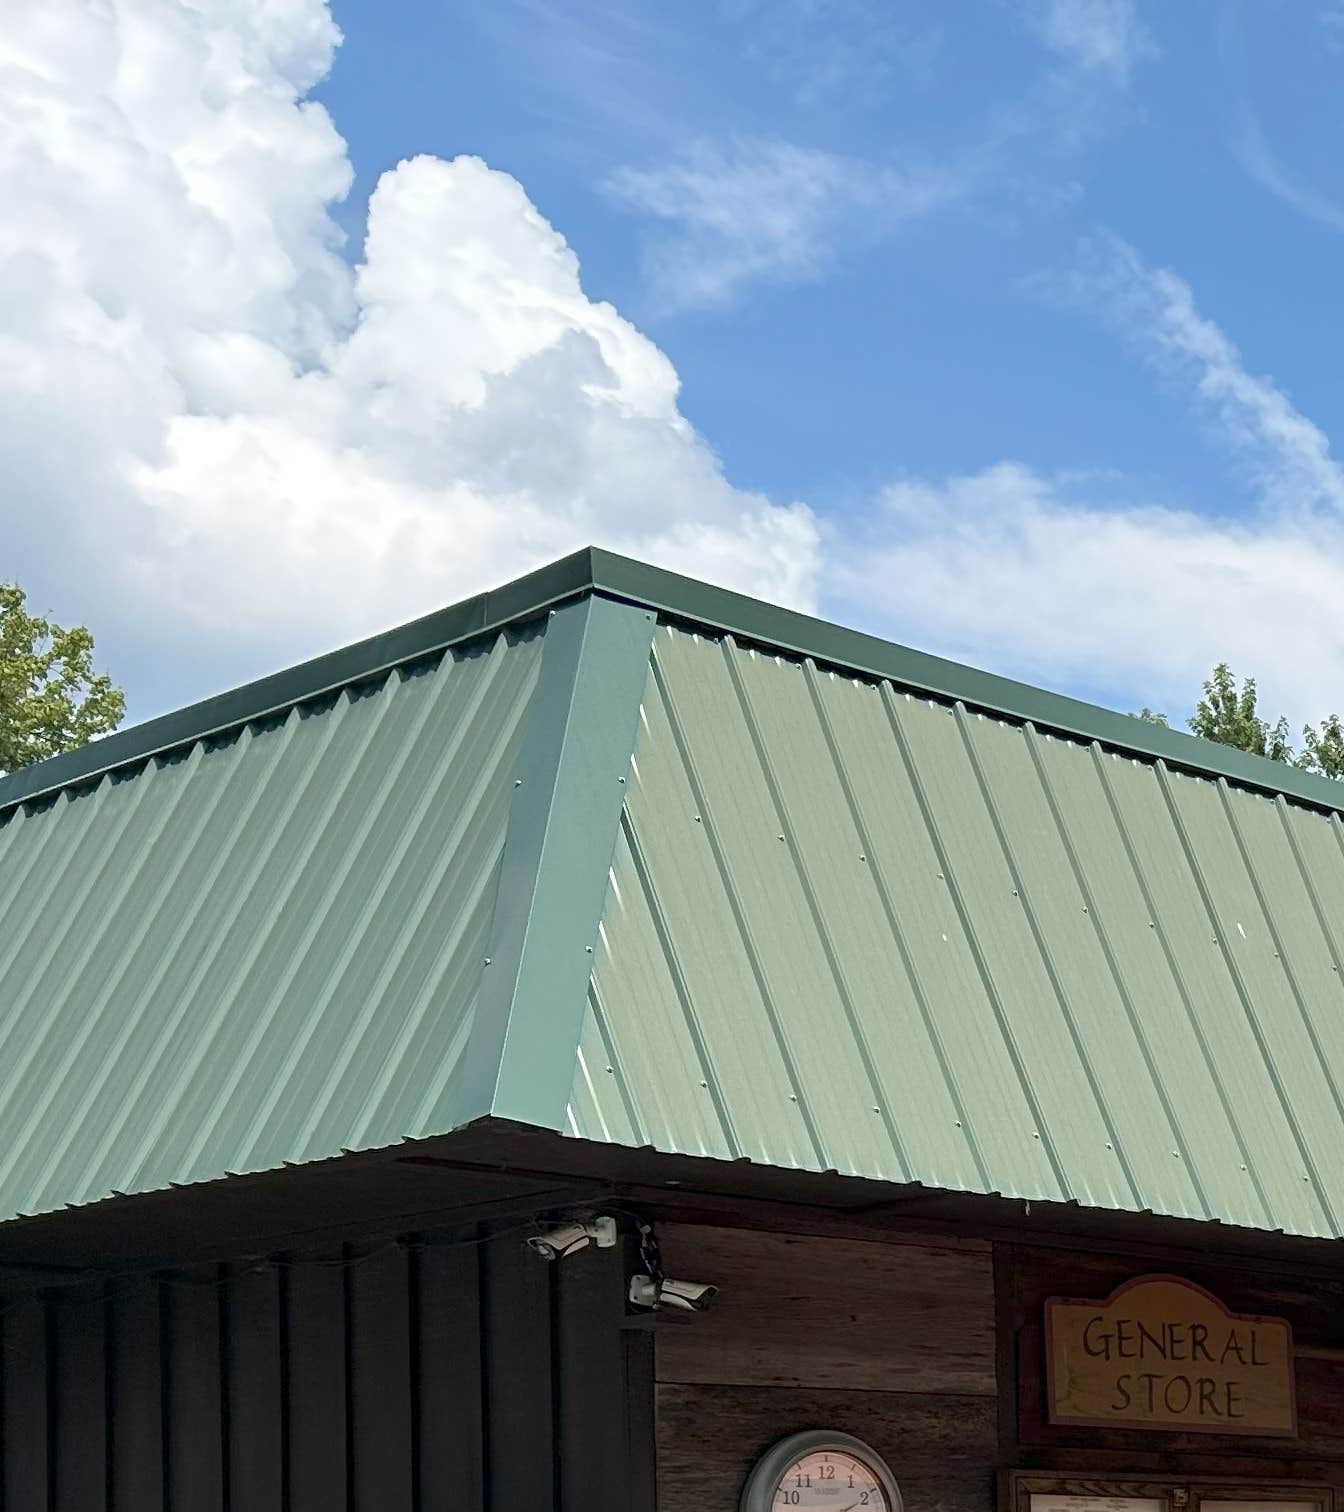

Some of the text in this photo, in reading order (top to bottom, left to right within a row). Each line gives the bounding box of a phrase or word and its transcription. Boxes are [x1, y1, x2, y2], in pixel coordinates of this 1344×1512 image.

[1082, 1315, 1270, 1366] GENERAL
[1111, 1374, 1245, 1419] STORE
[818, 1465, 835, 1480] 12
[795, 1474, 813, 1488] 11
[847, 1474, 855, 1488] 1
[782, 1491, 800, 1505] 10
[860, 1491, 869, 1506] 2
